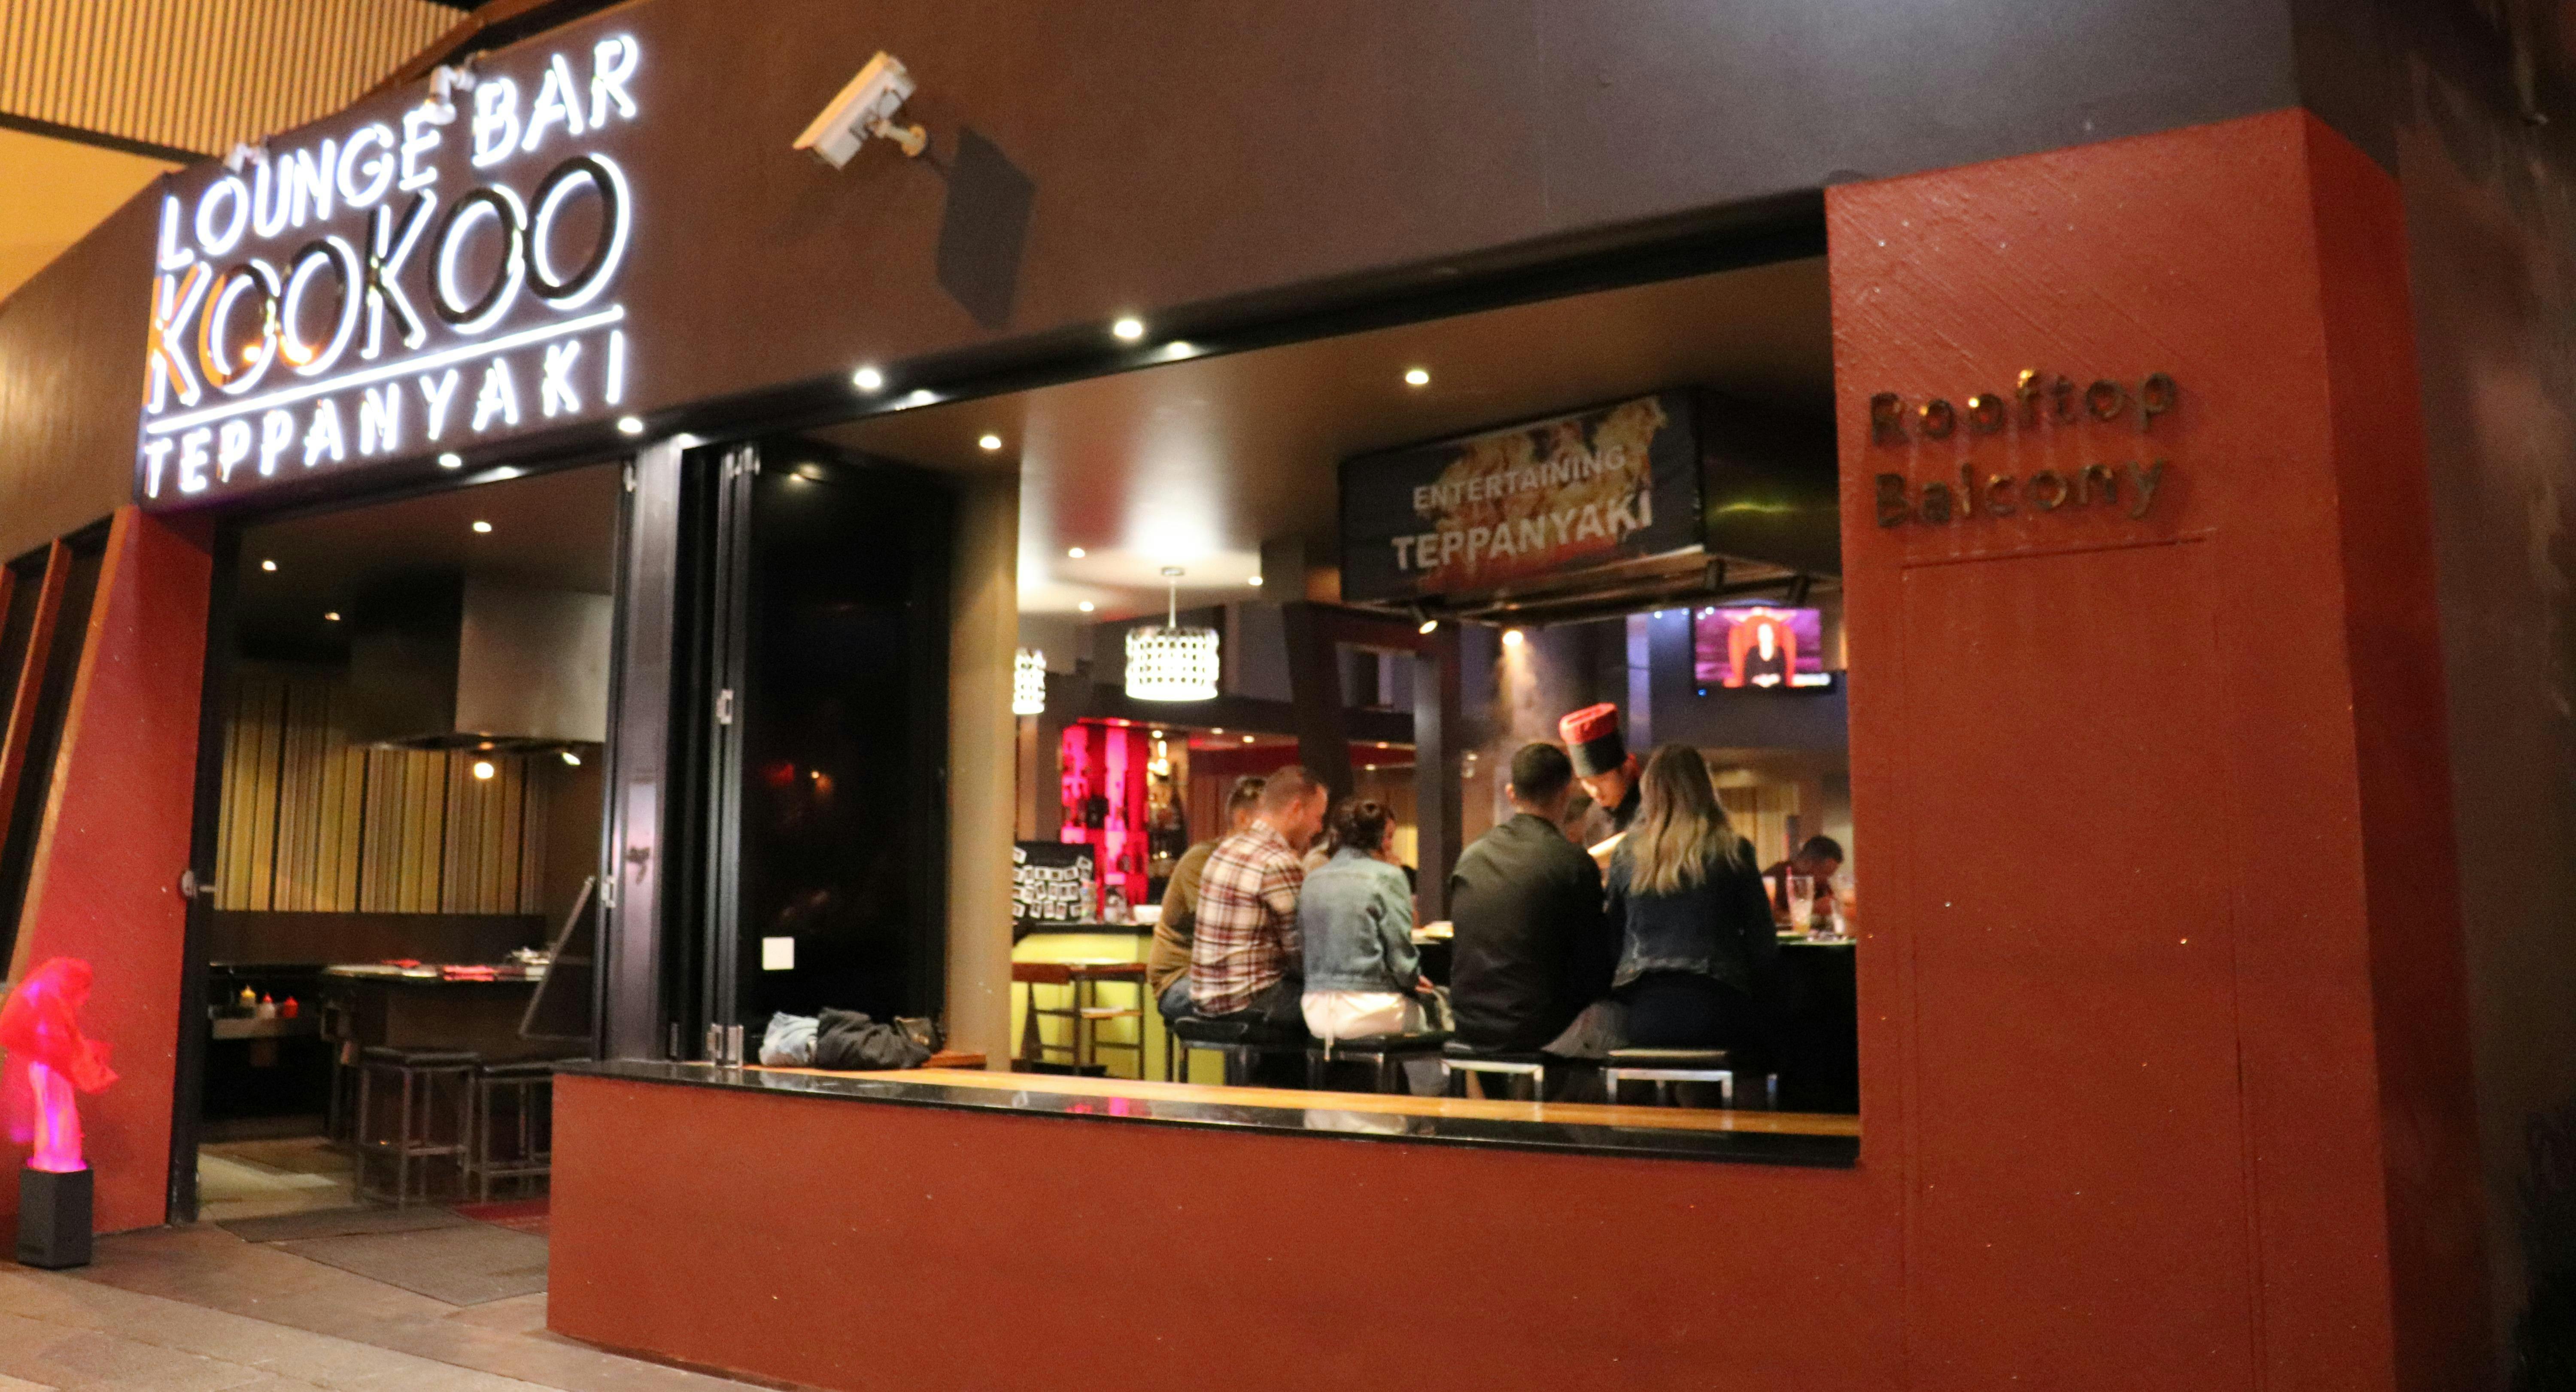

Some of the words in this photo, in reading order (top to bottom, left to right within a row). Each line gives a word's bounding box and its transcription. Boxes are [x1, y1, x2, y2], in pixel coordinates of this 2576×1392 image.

[161, 110, 441, 270] LOUNGE
[472, 33, 639, 167] BAR
[144, 153, 630, 415] KOOKOO
[143, 329, 625, 498] TEPPANYAKI
[1870, 367, 2177, 447] Rooftop
[1413, 444, 1626, 512] ENTERTAINING
[1874, 458, 2166, 529] Balcony
[1391, 488, 1653, 572] TEPPANYAKI
